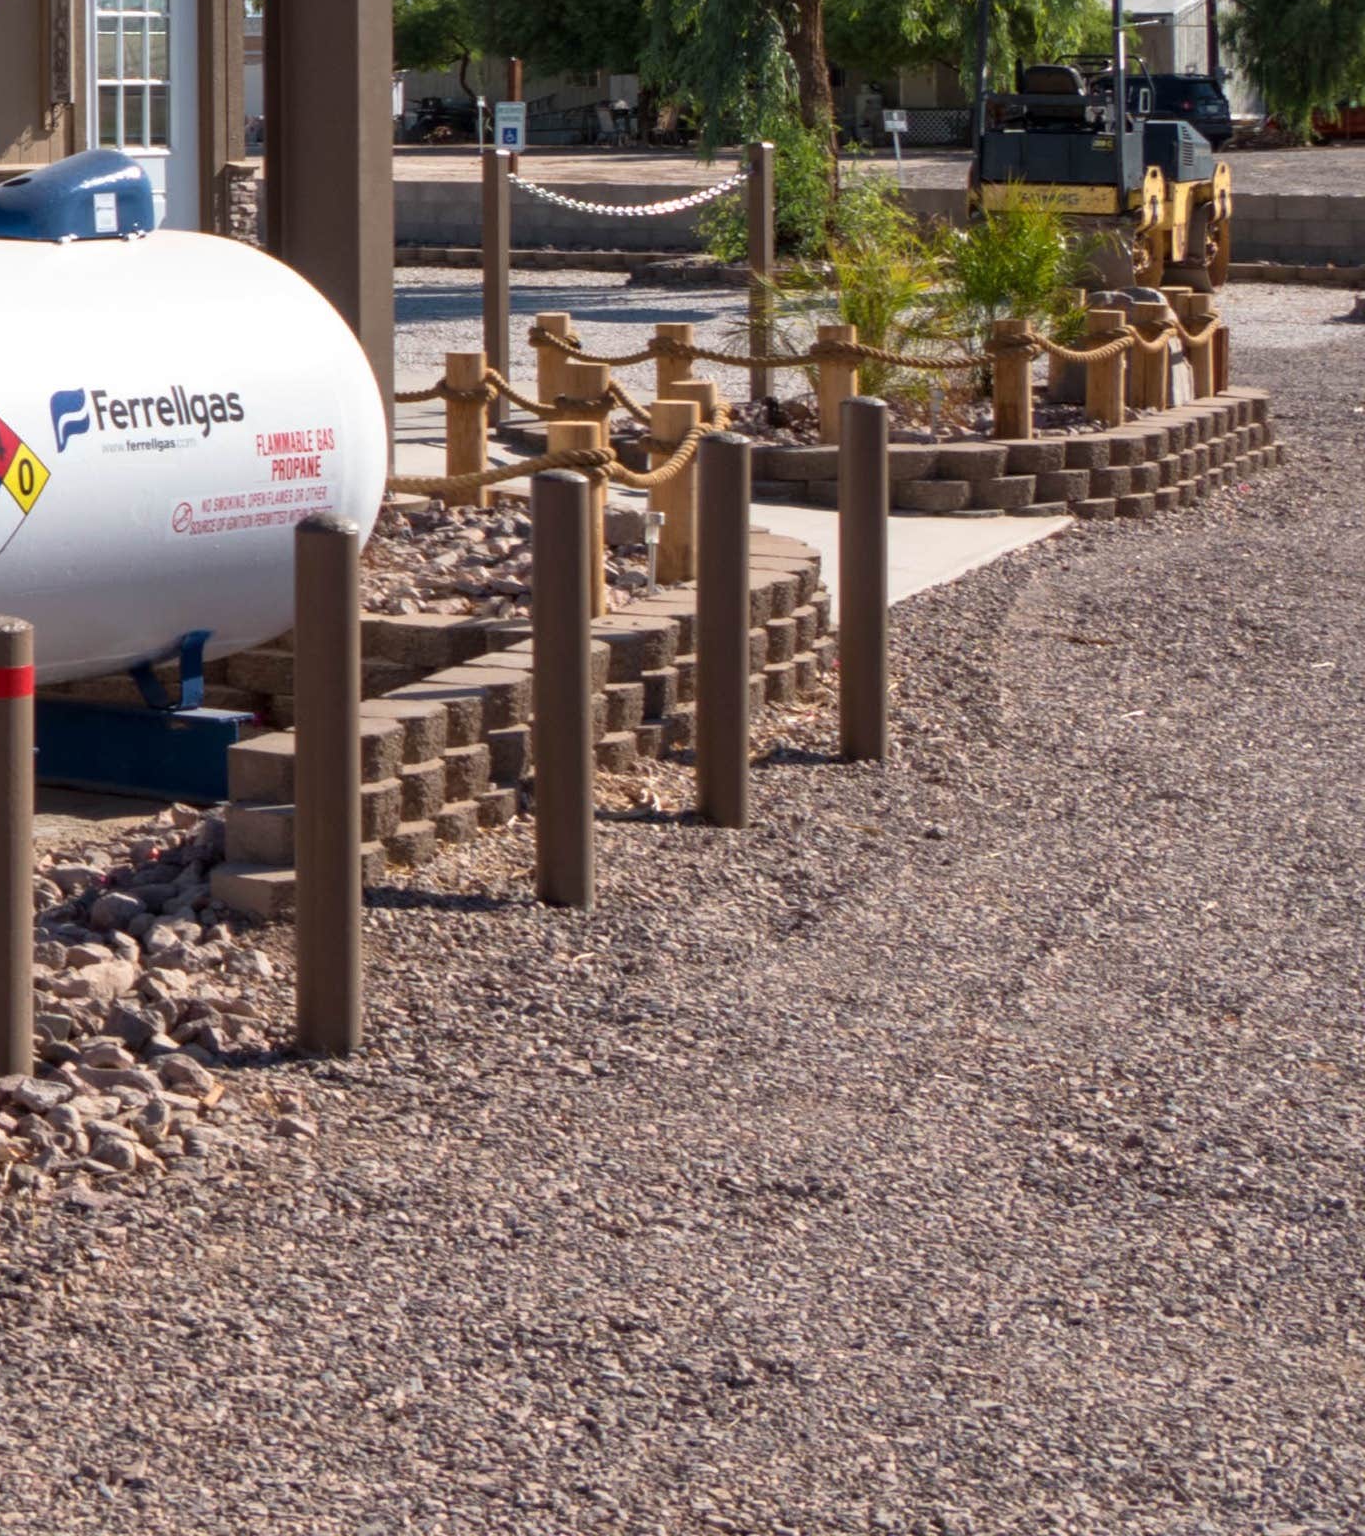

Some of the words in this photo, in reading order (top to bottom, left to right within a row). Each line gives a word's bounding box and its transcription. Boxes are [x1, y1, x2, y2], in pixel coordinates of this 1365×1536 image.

[91, 385, 245, 438] Ferrellgas
[102, 436, 197, 454] www.ferrellgas.com
[256, 430, 313, 456] FLAMMABLE
[316, 428, 336, 451] GAS
[18, 458, 35, 496] 0
[271, 455, 321, 481] PROPANE
[213, 493, 245, 512] SMOKING
